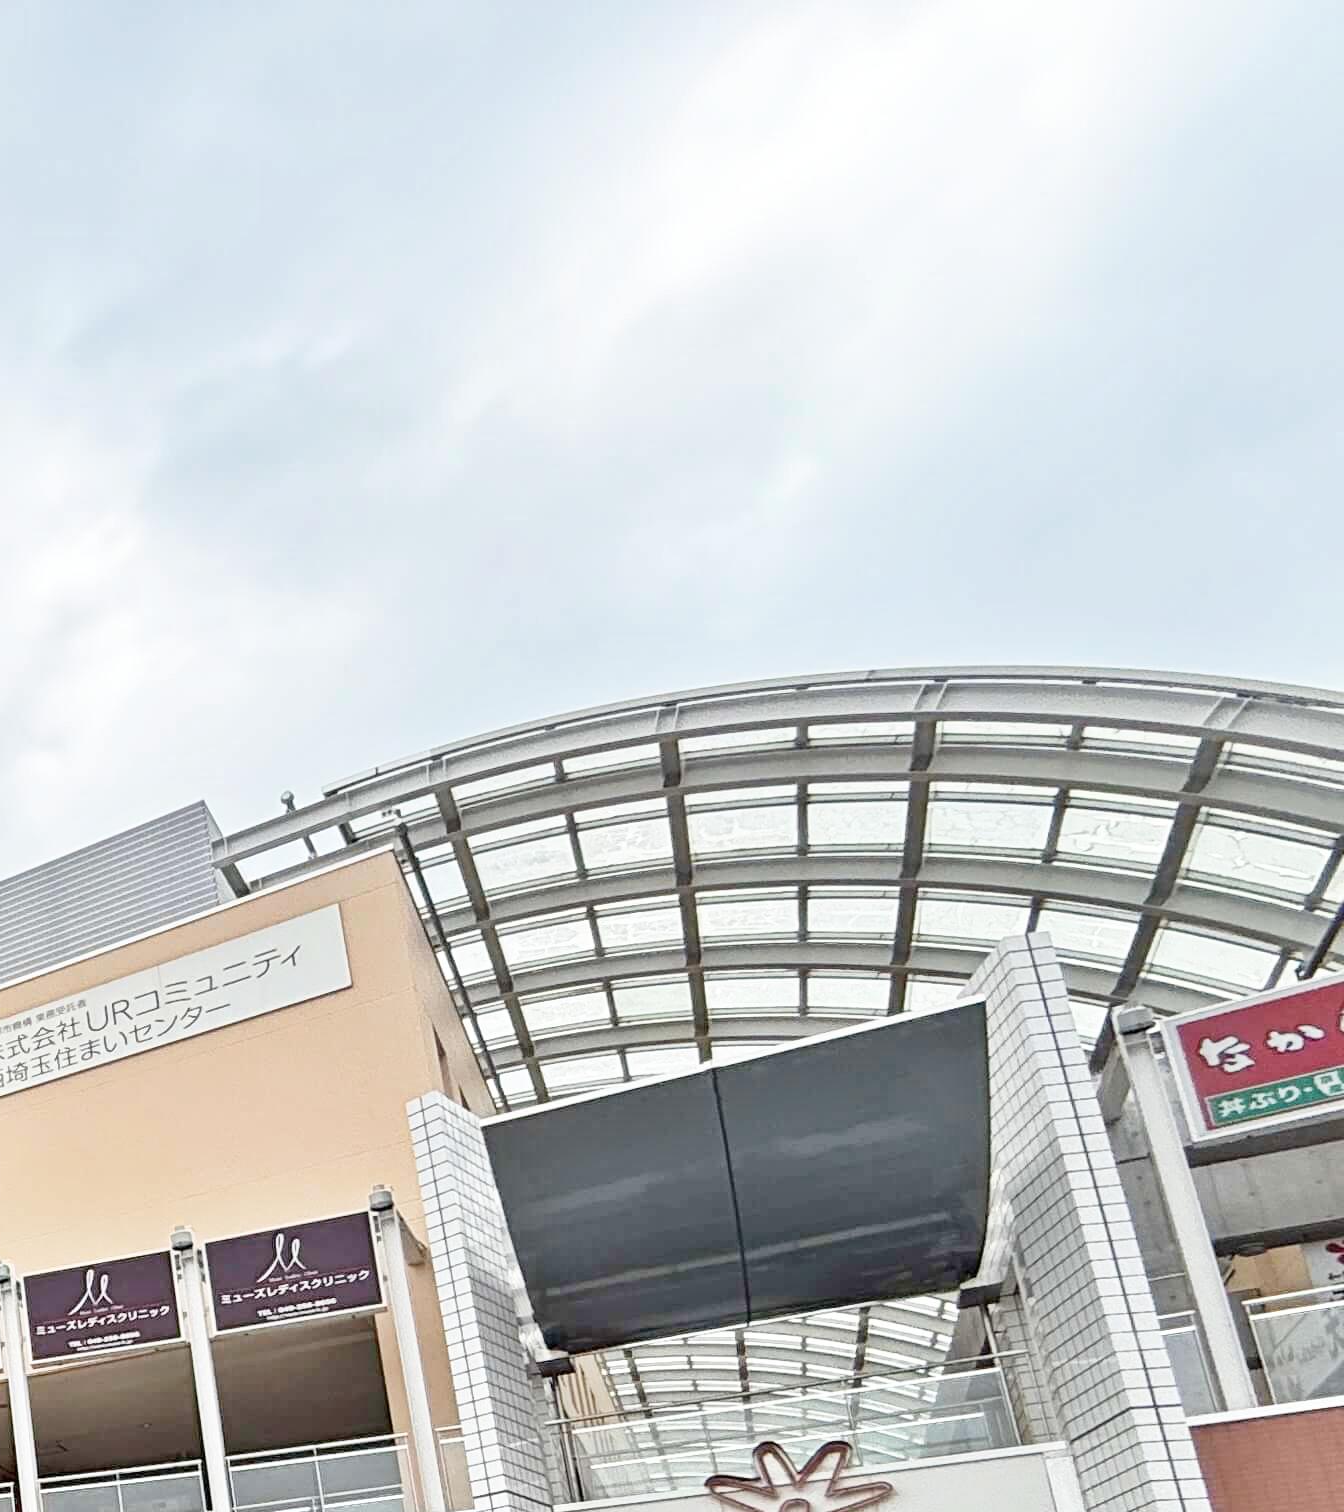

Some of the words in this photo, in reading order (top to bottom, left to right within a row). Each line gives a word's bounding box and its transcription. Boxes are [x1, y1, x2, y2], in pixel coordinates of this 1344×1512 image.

[1199, 1009, 1344, 1073] なか
[220, 1268, 370, 1305] ミューズレディスクリニック
[35, 1304, 170, 1336] ミューズレディスクリニック
